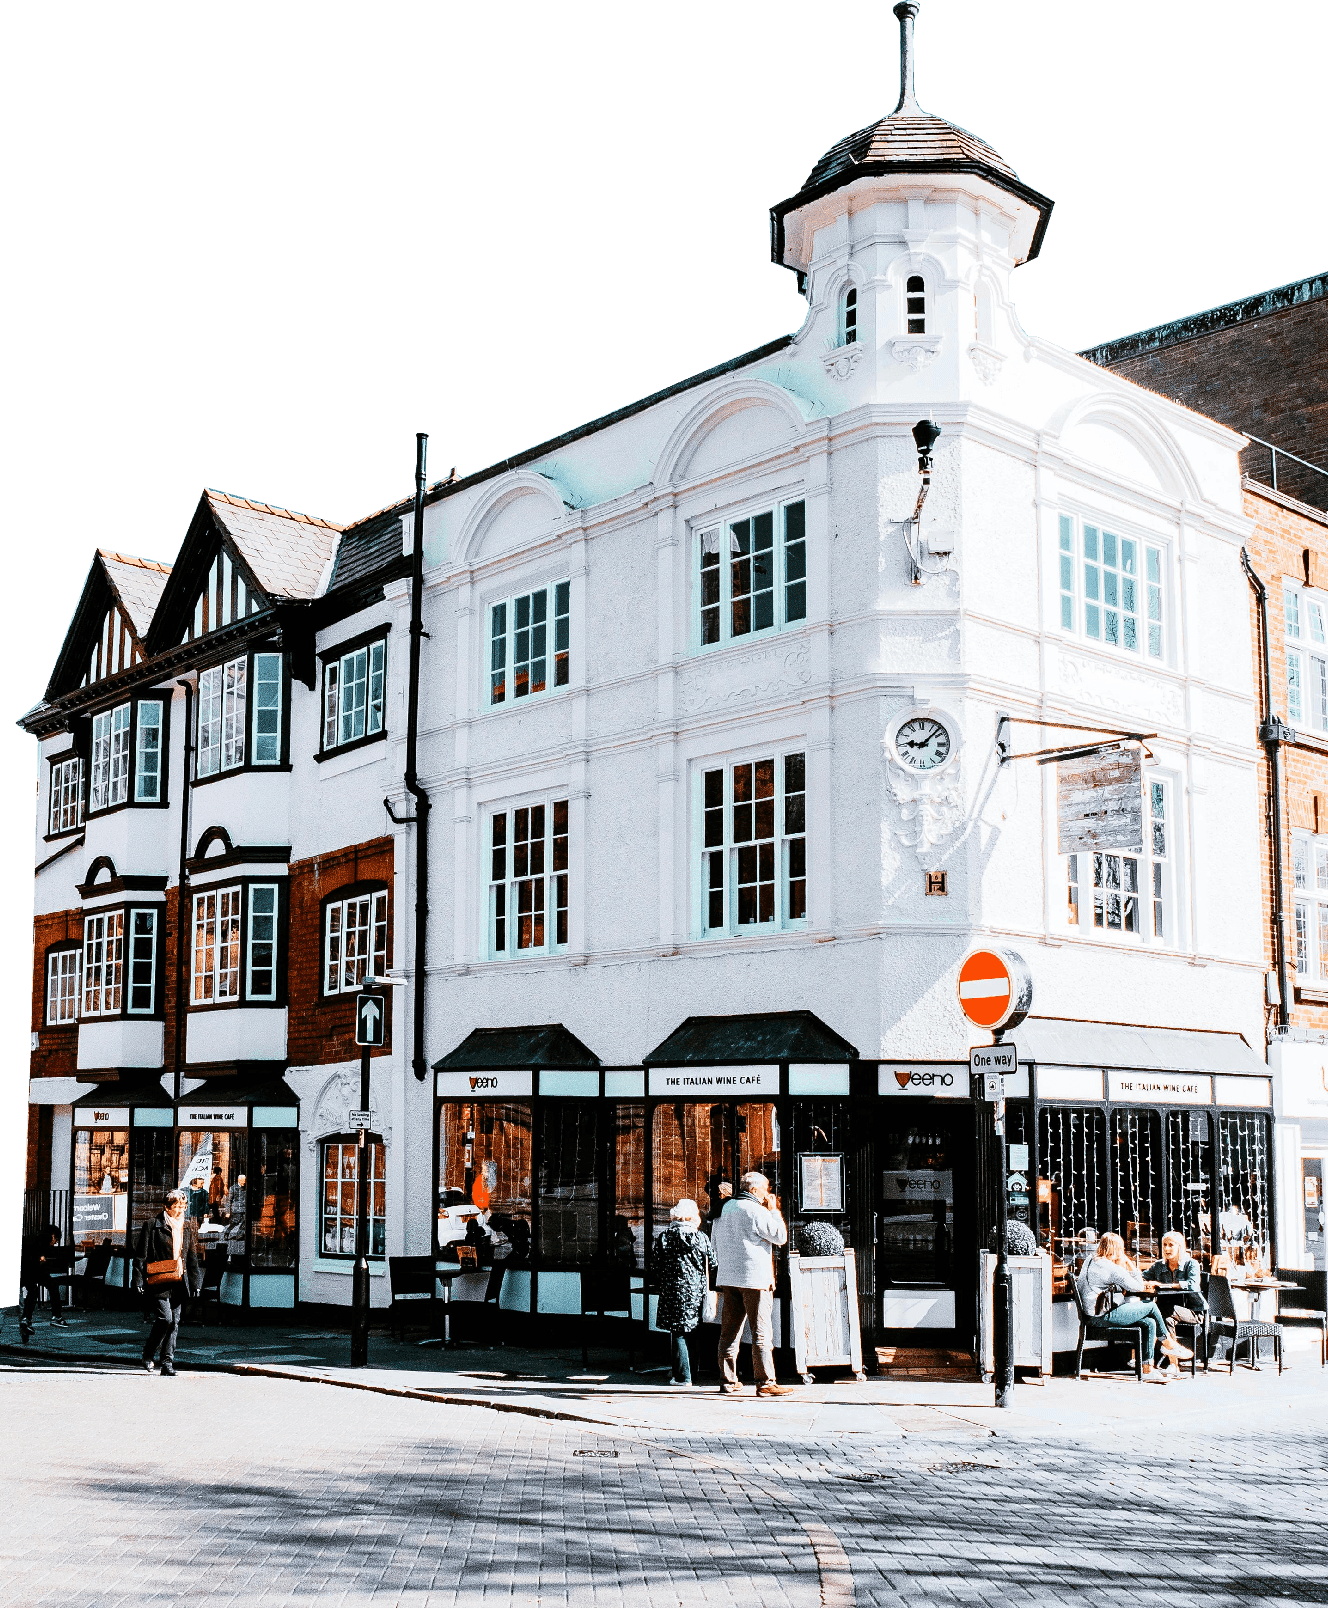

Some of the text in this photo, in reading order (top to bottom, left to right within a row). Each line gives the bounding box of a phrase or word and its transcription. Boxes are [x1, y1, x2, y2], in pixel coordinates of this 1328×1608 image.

[973, 1053, 1012, 1067] One way
[665, 1074, 761, 1085] THE ITALIAN WINE CAFÉ
[894, 1070, 954, 1090] Veeno
[1120, 1082, 1133, 1090] THE
[1163, 1084, 1180, 1092] WINE
